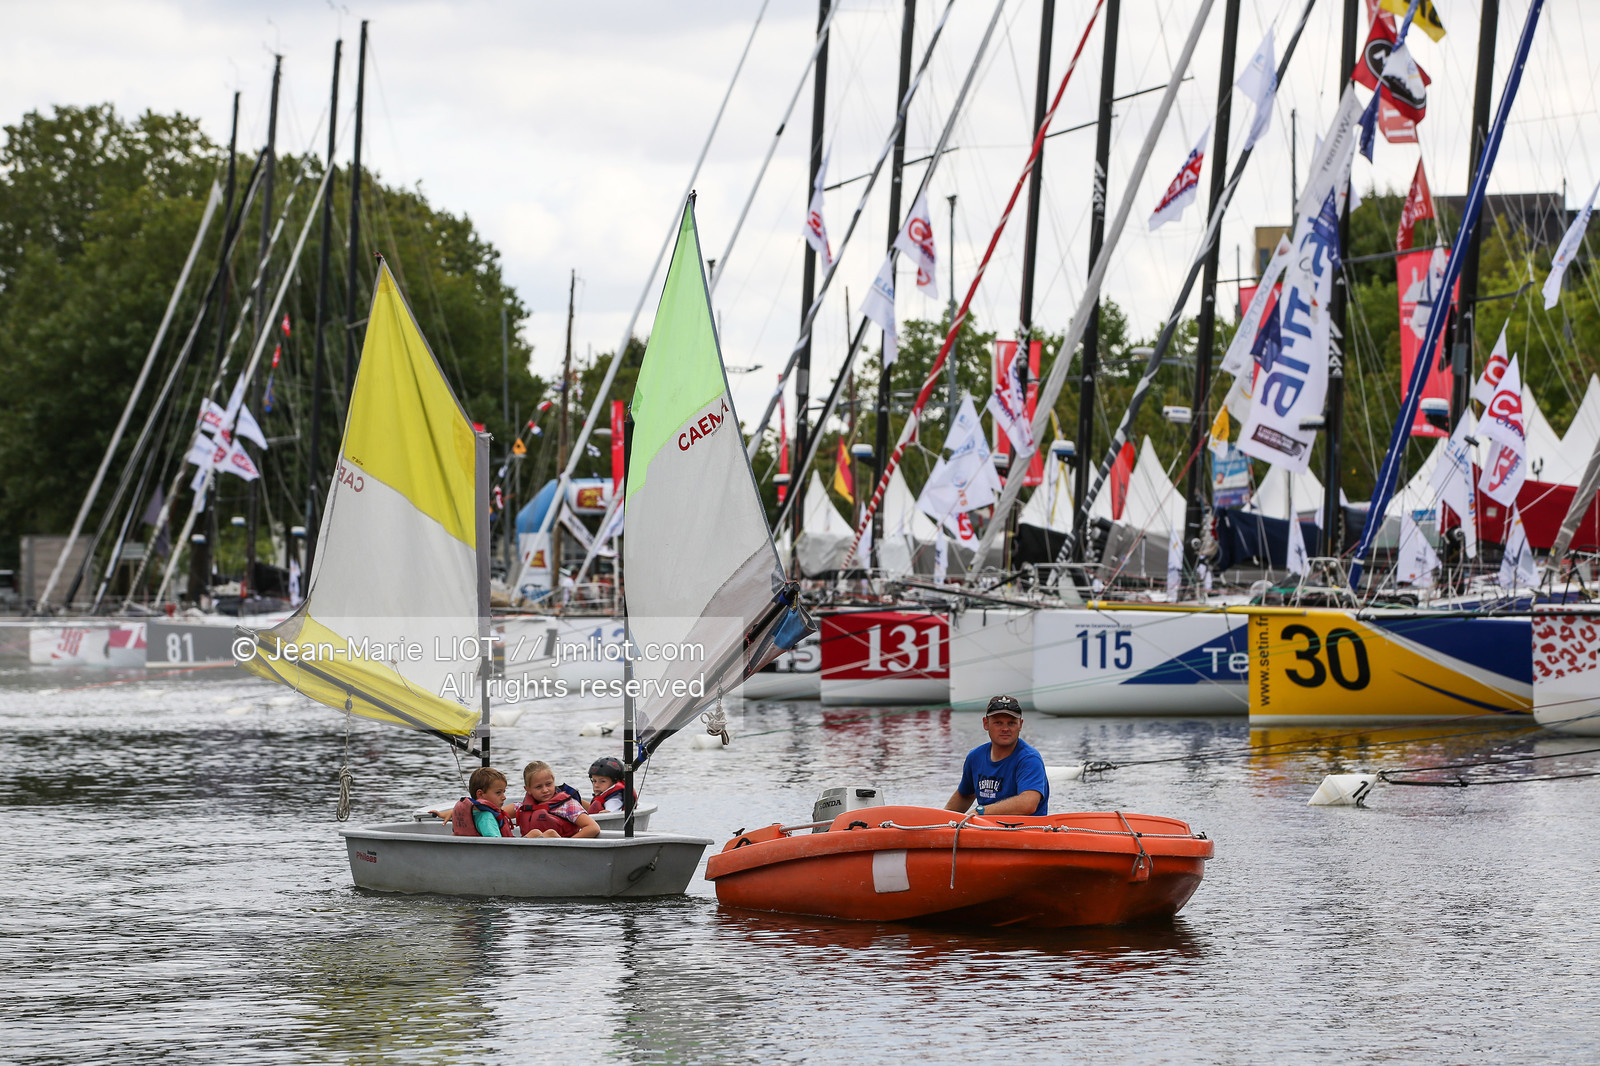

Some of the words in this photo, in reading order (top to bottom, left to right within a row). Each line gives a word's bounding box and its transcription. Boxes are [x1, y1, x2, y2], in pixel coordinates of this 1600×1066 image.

[166, 632, 194, 663] 81
[861, 623, 947, 672] 131
[1076, 630, 1133, 670] 115
[1256, 614, 1270, 707] www.setin.fr
[1281, 624, 1371, 691] 30
